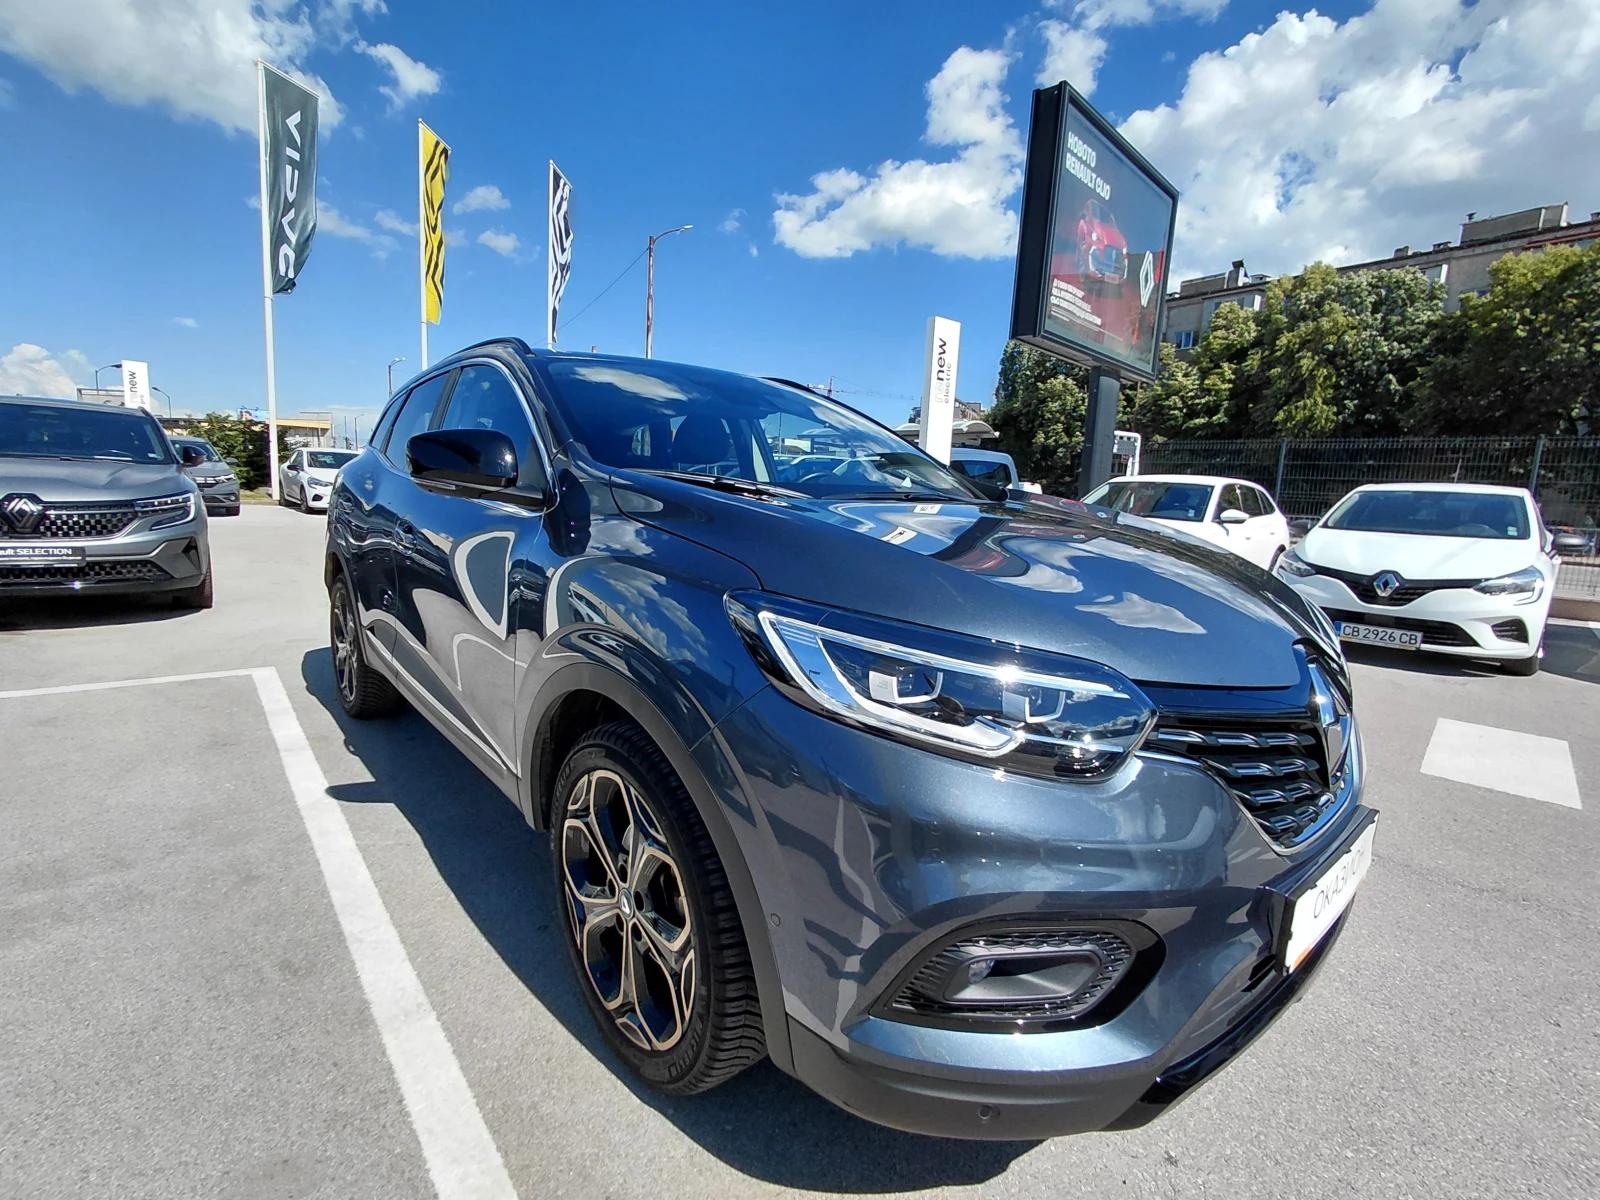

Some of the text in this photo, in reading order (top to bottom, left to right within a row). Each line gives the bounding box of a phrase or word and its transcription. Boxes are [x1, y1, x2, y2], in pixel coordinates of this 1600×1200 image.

[1067, 131, 1096, 168] НОВОТО
[278, 110, 302, 280] DACIA
[1065, 152, 1110, 201] RENAULT CLIO
[943, 362, 952, 404] electric
[1342, 625, 1360, 637] CB
[1362, 627, 1397, 643] 2926
[1398, 632, 1419, 646] CB
